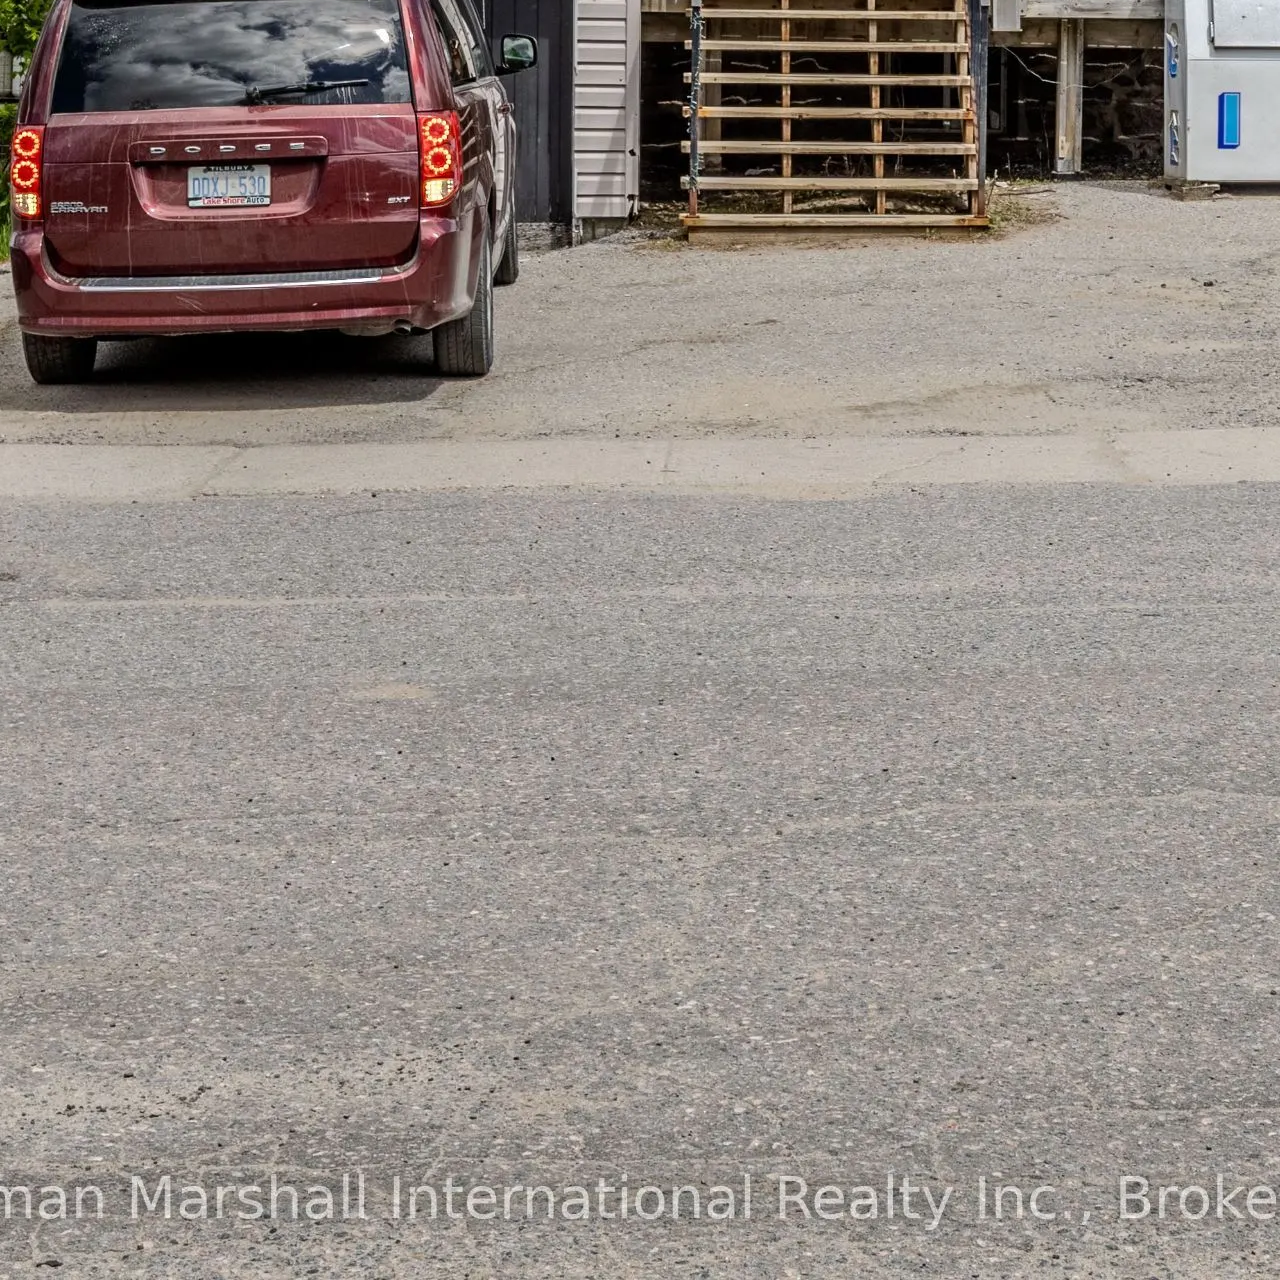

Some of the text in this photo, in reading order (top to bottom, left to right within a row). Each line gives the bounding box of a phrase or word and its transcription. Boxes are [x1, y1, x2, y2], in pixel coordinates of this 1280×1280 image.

[149, 142, 305, 154] DODGE
[239, 176, 265, 195] 530
[202, 197, 221, 205] Lake
